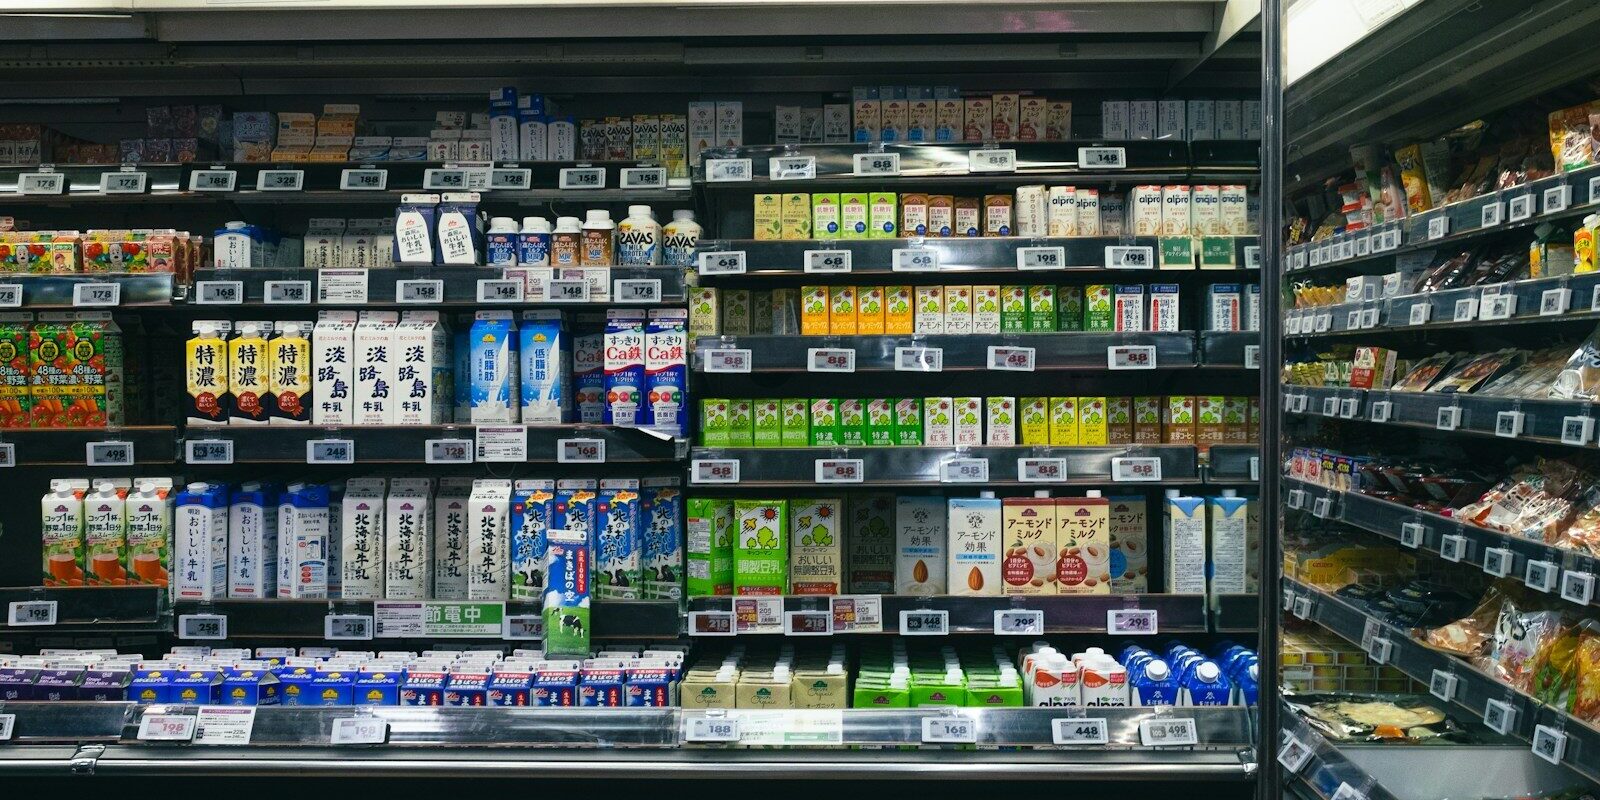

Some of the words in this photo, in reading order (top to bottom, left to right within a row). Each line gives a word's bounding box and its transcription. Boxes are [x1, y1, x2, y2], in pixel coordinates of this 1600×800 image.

[582, 129, 605, 137] SAVAS
[607, 126, 631, 135] SAVAS
[634, 125, 657, 133] SAVAS
[661, 124, 684, 133] SAVAS
[1053, 196, 1074, 206] alpro
[1139, 195, 1160, 204] alpro
[1167, 195, 1188, 204] alpro
[620, 232, 653, 245] SAVAS
[664, 236, 697, 248] SAVAS
[93, 290, 111, 298] 178
[1091, 320, 1108, 328] 抹茶
[609, 336, 640, 345] すっきり
[651, 336, 681, 345] すっきり
[606, 346, 641, 360] Ca鉄
[648, 346, 683, 360] Ca鉄
[196, 345, 215, 386] 特濃
[238, 344, 257, 386] 特濃
[278, 344, 298, 386] 特濃
[485, 350, 494, 381] 低脂肪
[535, 349, 545, 380] 低脂肪
[319, 346, 348, 398] 淡路島
[360, 346, 389, 398] 淡路島
[399, 346, 427, 398] 淡路島
[322, 402, 342, 411] 牛乳
[363, 402, 383, 411] 牛乳
[402, 402, 421, 411] 牛乳
[930, 433, 948, 441] 紅茶
[959, 433, 976, 441] 紅茶
[992, 433, 1009, 441] 紅茶
[106, 450, 125, 458] 498
[445, 447, 464, 455] 128
[1133, 465, 1152, 473] 88
[1008, 519, 1052, 529] アーモンド
[1062, 518, 1105, 528] アーモンド
[904, 526, 939, 535] アーモンド
[1017, 530, 1042, 540] ミルク
[1071, 530, 1095, 539] ミルク
[910, 536, 931, 545] 効果
[957, 531, 995, 541] アーモンド
[187, 517, 198, 581] おいしい牛乳
[240, 515, 250, 578] おいしい牛乳
[355, 514, 370, 579] 北海道牛乳
[399, 514, 414, 579] 北海道牛乳
[447, 512, 461, 578] 北海道牛乳
[965, 542, 986, 552] 効果
[481, 516, 496, 584] 北海道牛乳
[798, 556, 831, 565] おいしい
[738, 560, 781, 573] 調製豆乳
[794, 565, 836, 575] 無調整豆乳
[564, 550, 575, 600] まきばの空
[29, 609, 48, 617] 198
[425, 606, 481, 622] 節電中
[709, 619, 728, 627] 218
[805, 619, 824, 627] 218
[924, 617, 940, 625] 448
[346, 624, 364, 632] 218
[161, 723, 184, 732] 198
[355, 726, 376, 735] 198
[709, 726, 730, 734] 188
[944, 726, 967, 734] 168
[1076, 727, 1098, 735] 448
[1168, 726, 1186, 734] 498
